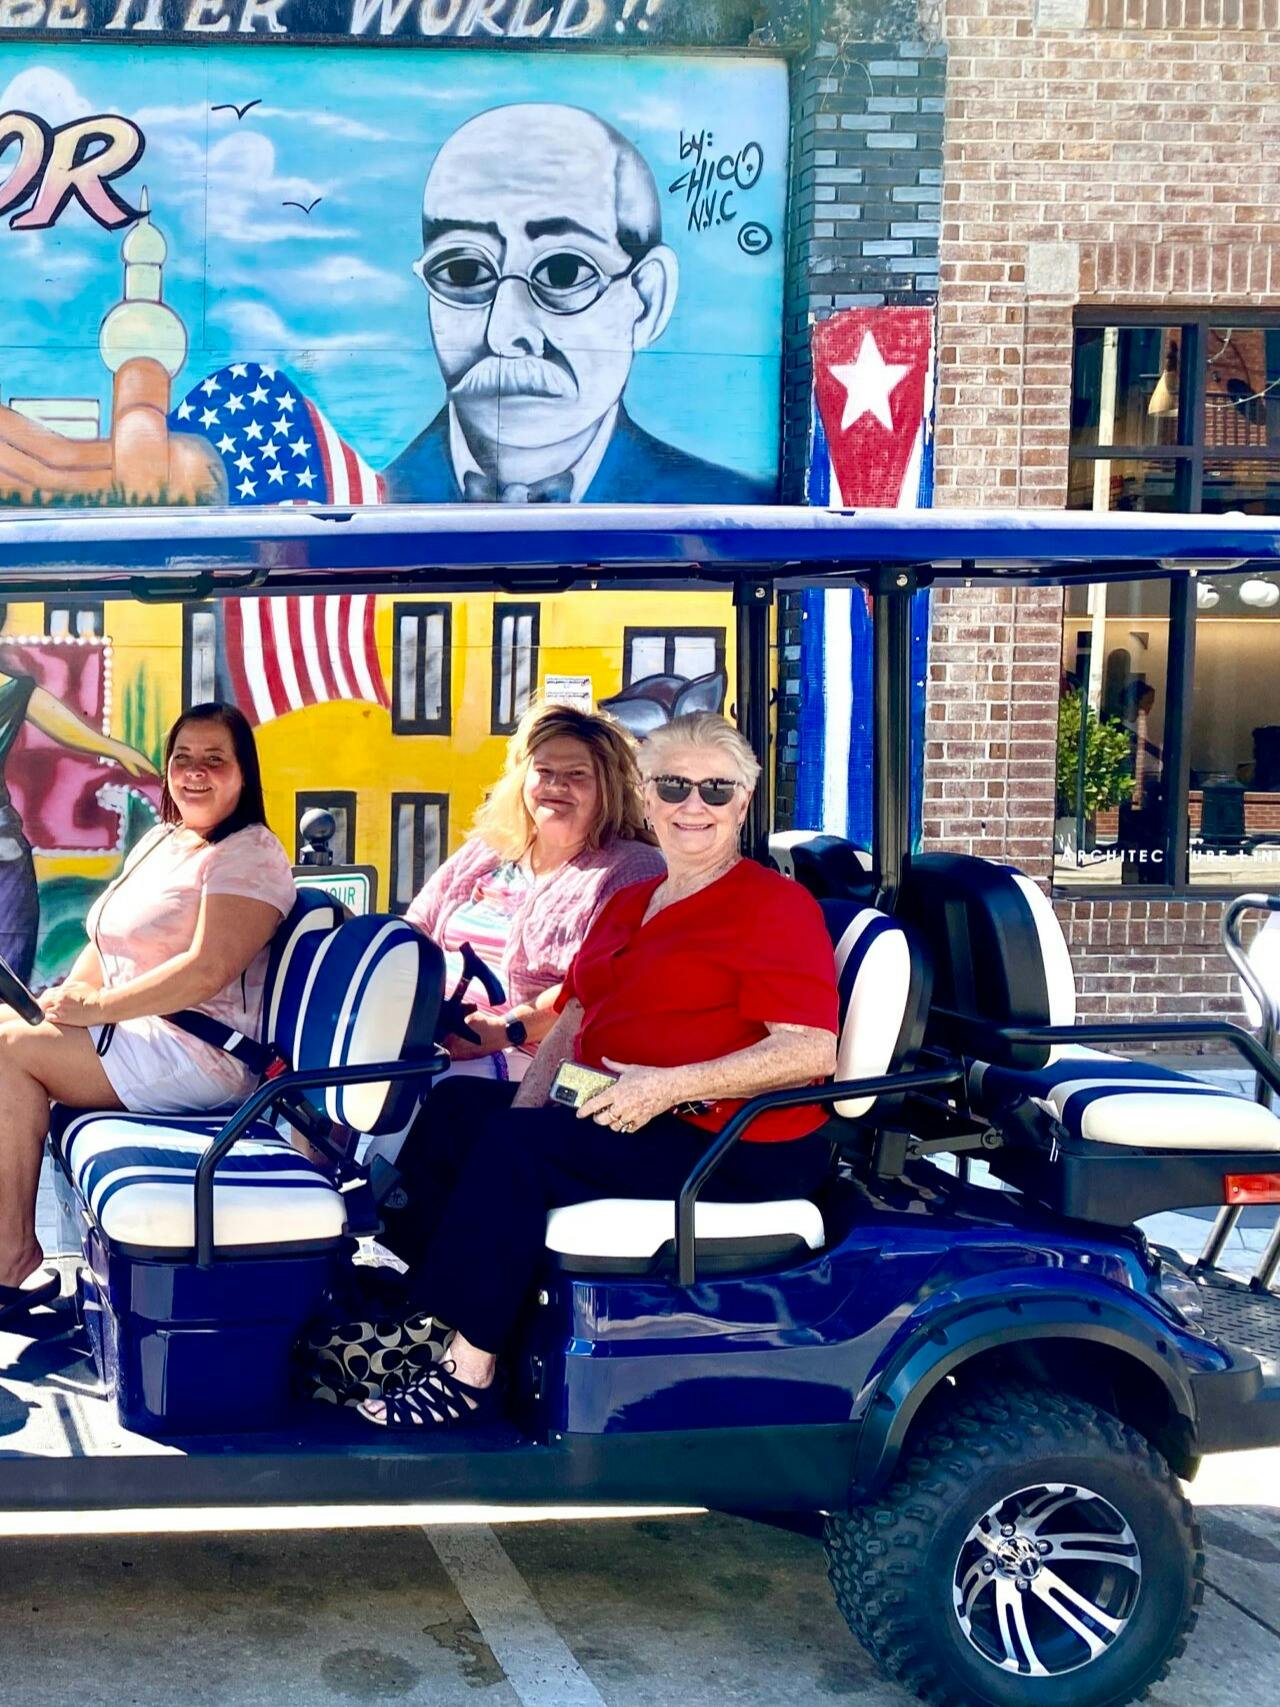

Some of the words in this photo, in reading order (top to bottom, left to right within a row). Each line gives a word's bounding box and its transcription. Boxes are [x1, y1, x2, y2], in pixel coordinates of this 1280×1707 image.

[668, 141, 764, 203] CHICO
[1061, 848, 1228, 864] ARCHITECURE
[322, 886, 356, 905] OUR
